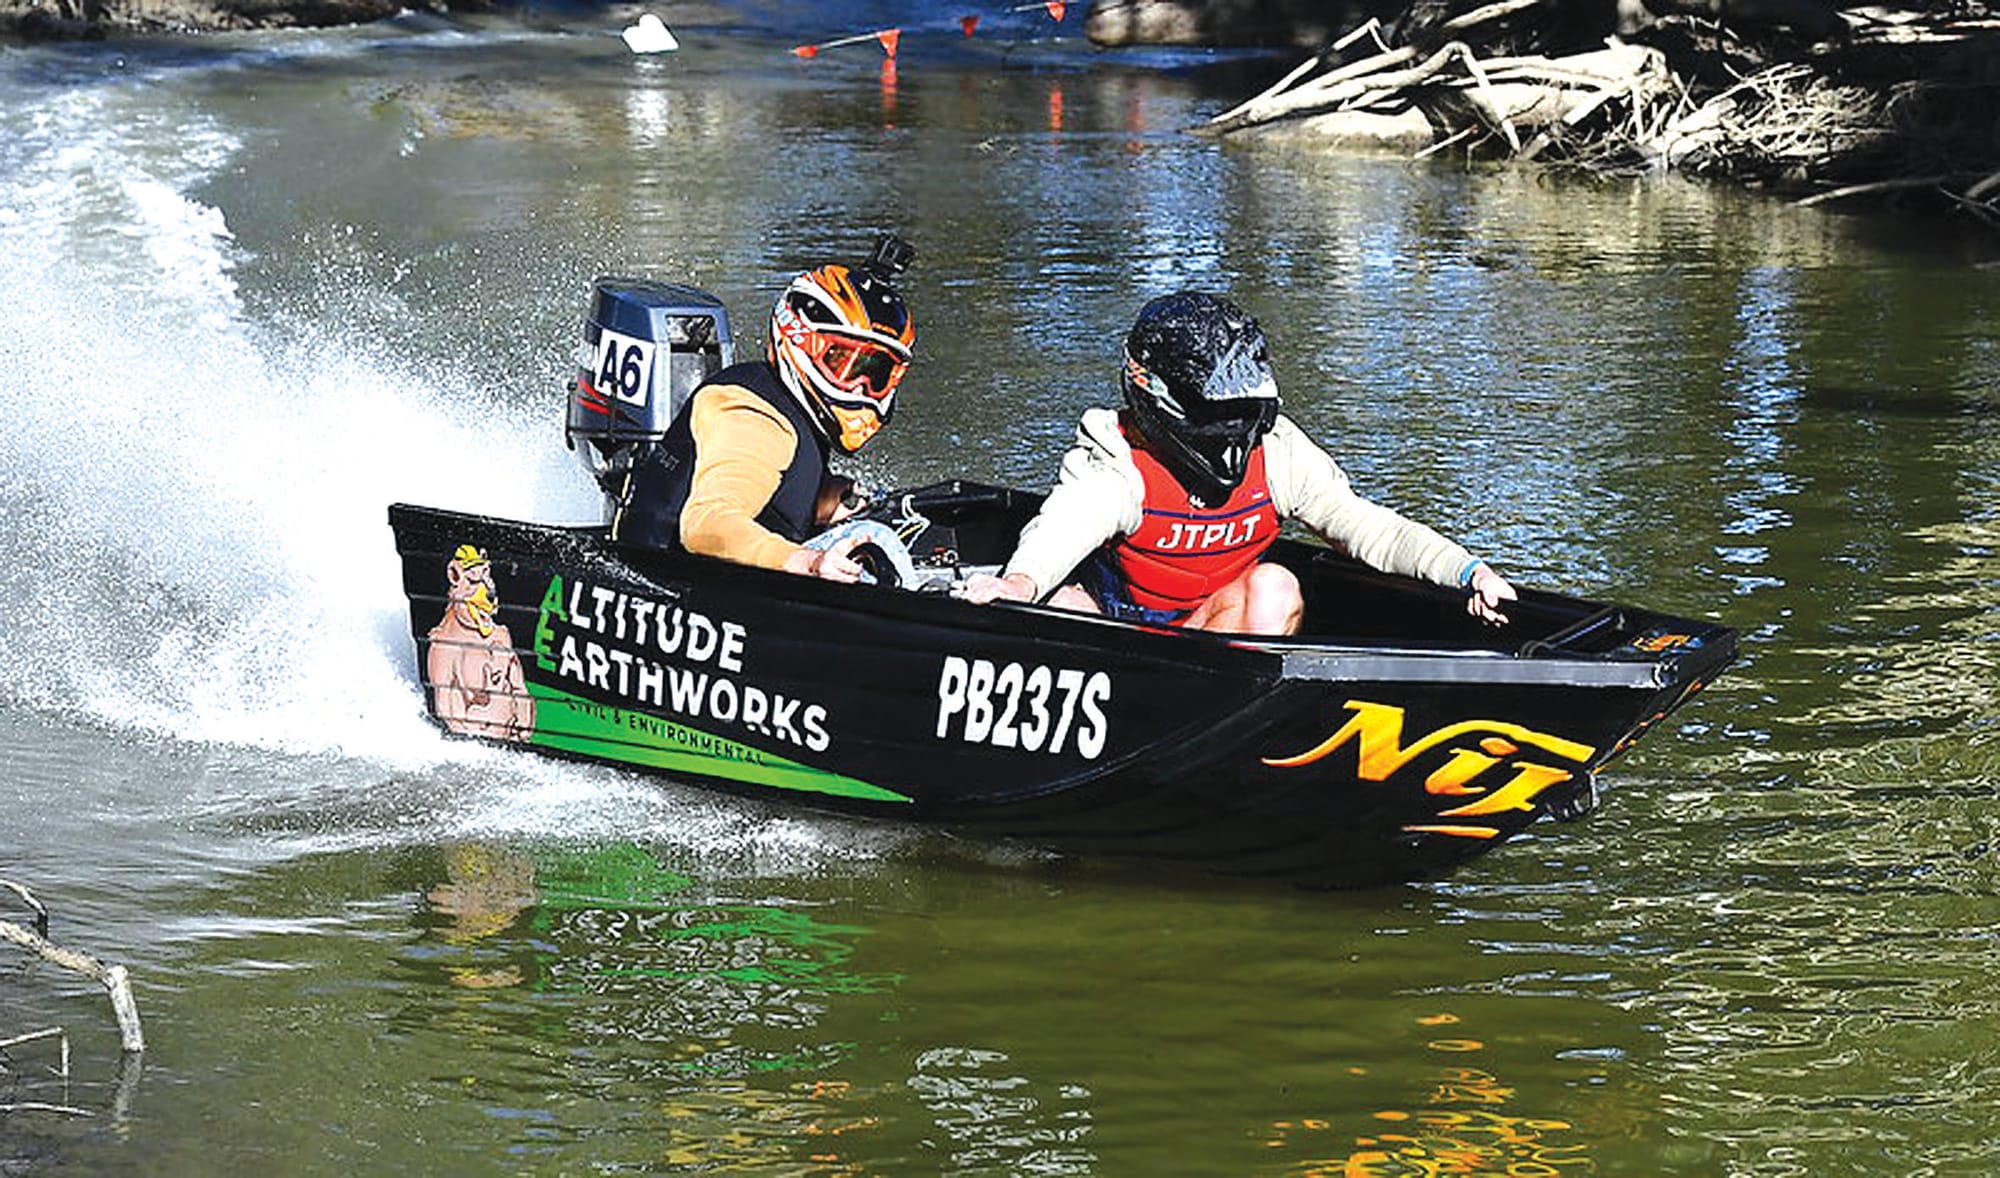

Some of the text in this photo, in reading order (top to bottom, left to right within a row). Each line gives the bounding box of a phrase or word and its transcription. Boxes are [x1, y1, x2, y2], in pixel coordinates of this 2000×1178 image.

[598, 339, 643, 398] A6
[1156, 514, 1261, 551] JTPLT
[540, 573, 747, 673] ALTITUDE
[534, 611, 831, 752] EARTHWORKS
[936, 656, 1111, 760] PB237S
[563, 697, 607, 721] CIVIL
[629, 714, 765, 766] ENVIRONMENTAL
